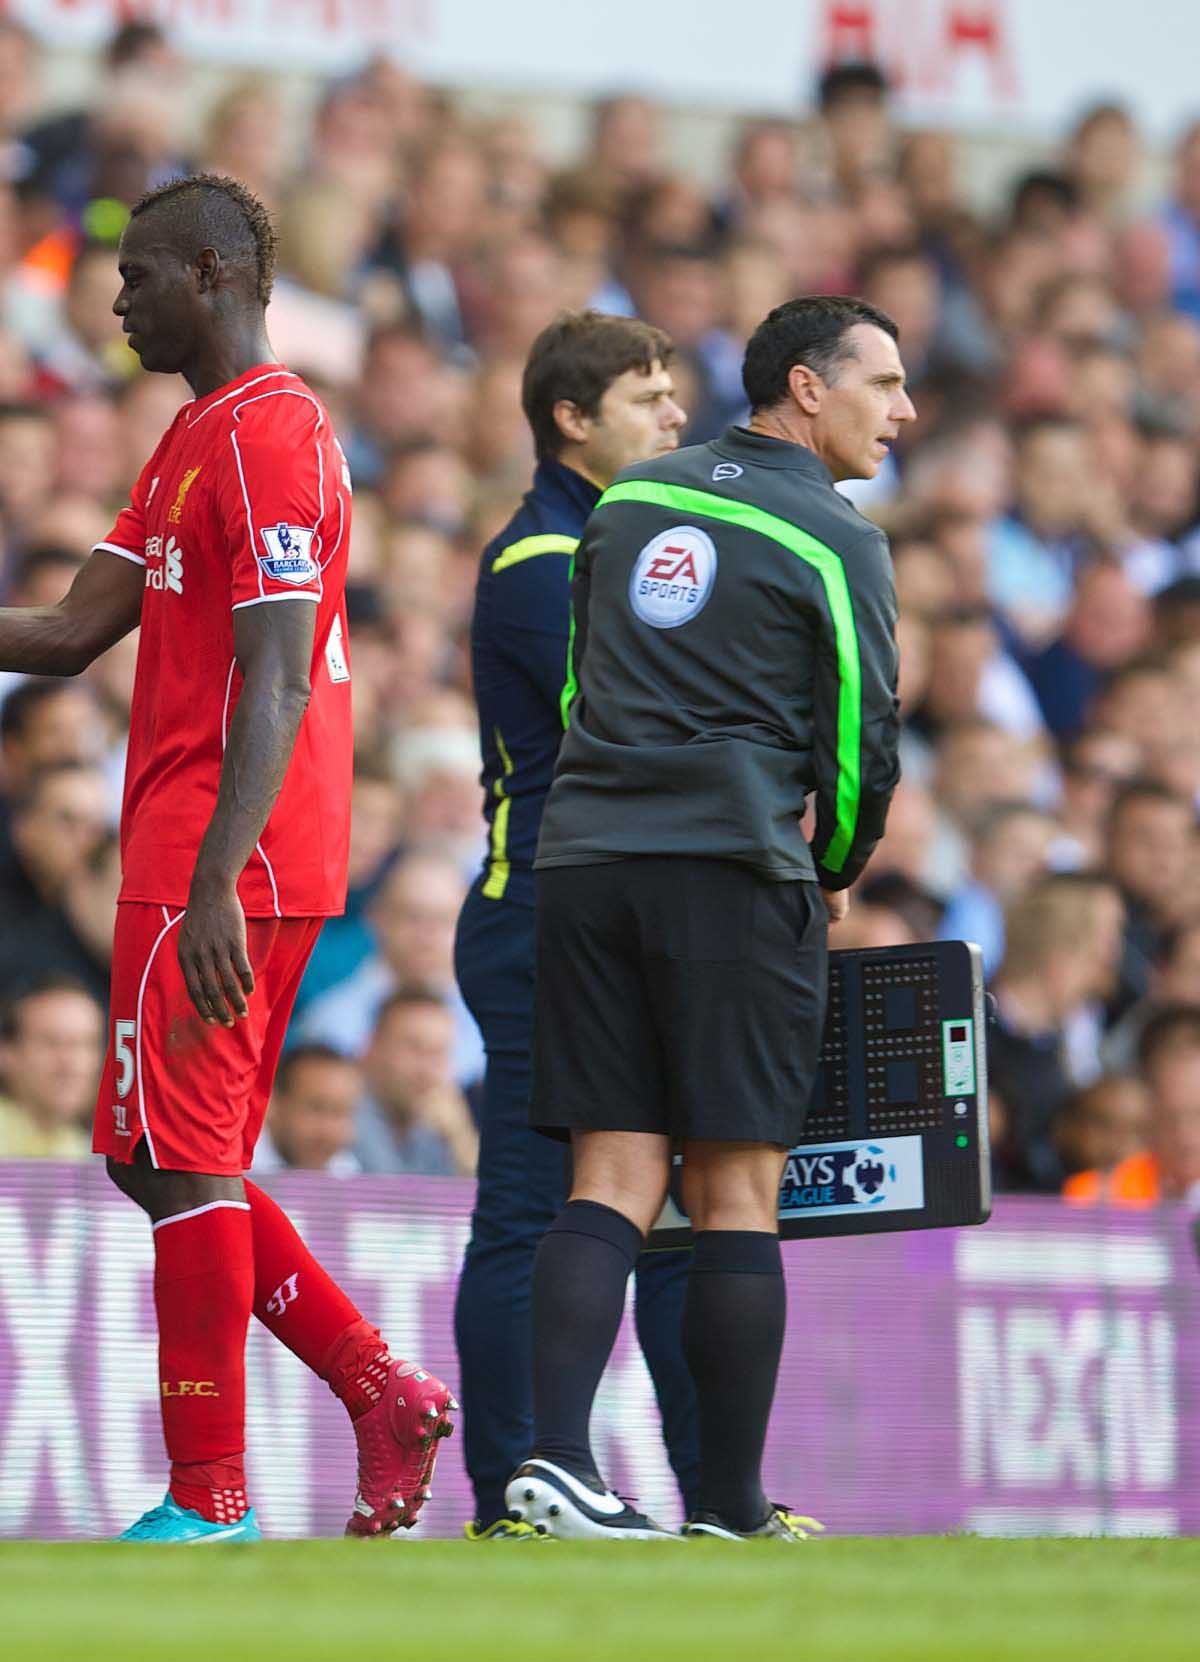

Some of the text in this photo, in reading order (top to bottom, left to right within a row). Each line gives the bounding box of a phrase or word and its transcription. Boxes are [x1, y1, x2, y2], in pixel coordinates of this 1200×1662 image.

[645, 546, 698, 585] EA
[638, 580, 698, 603] SPORTS
[115, 1019, 136, 1099] 5
